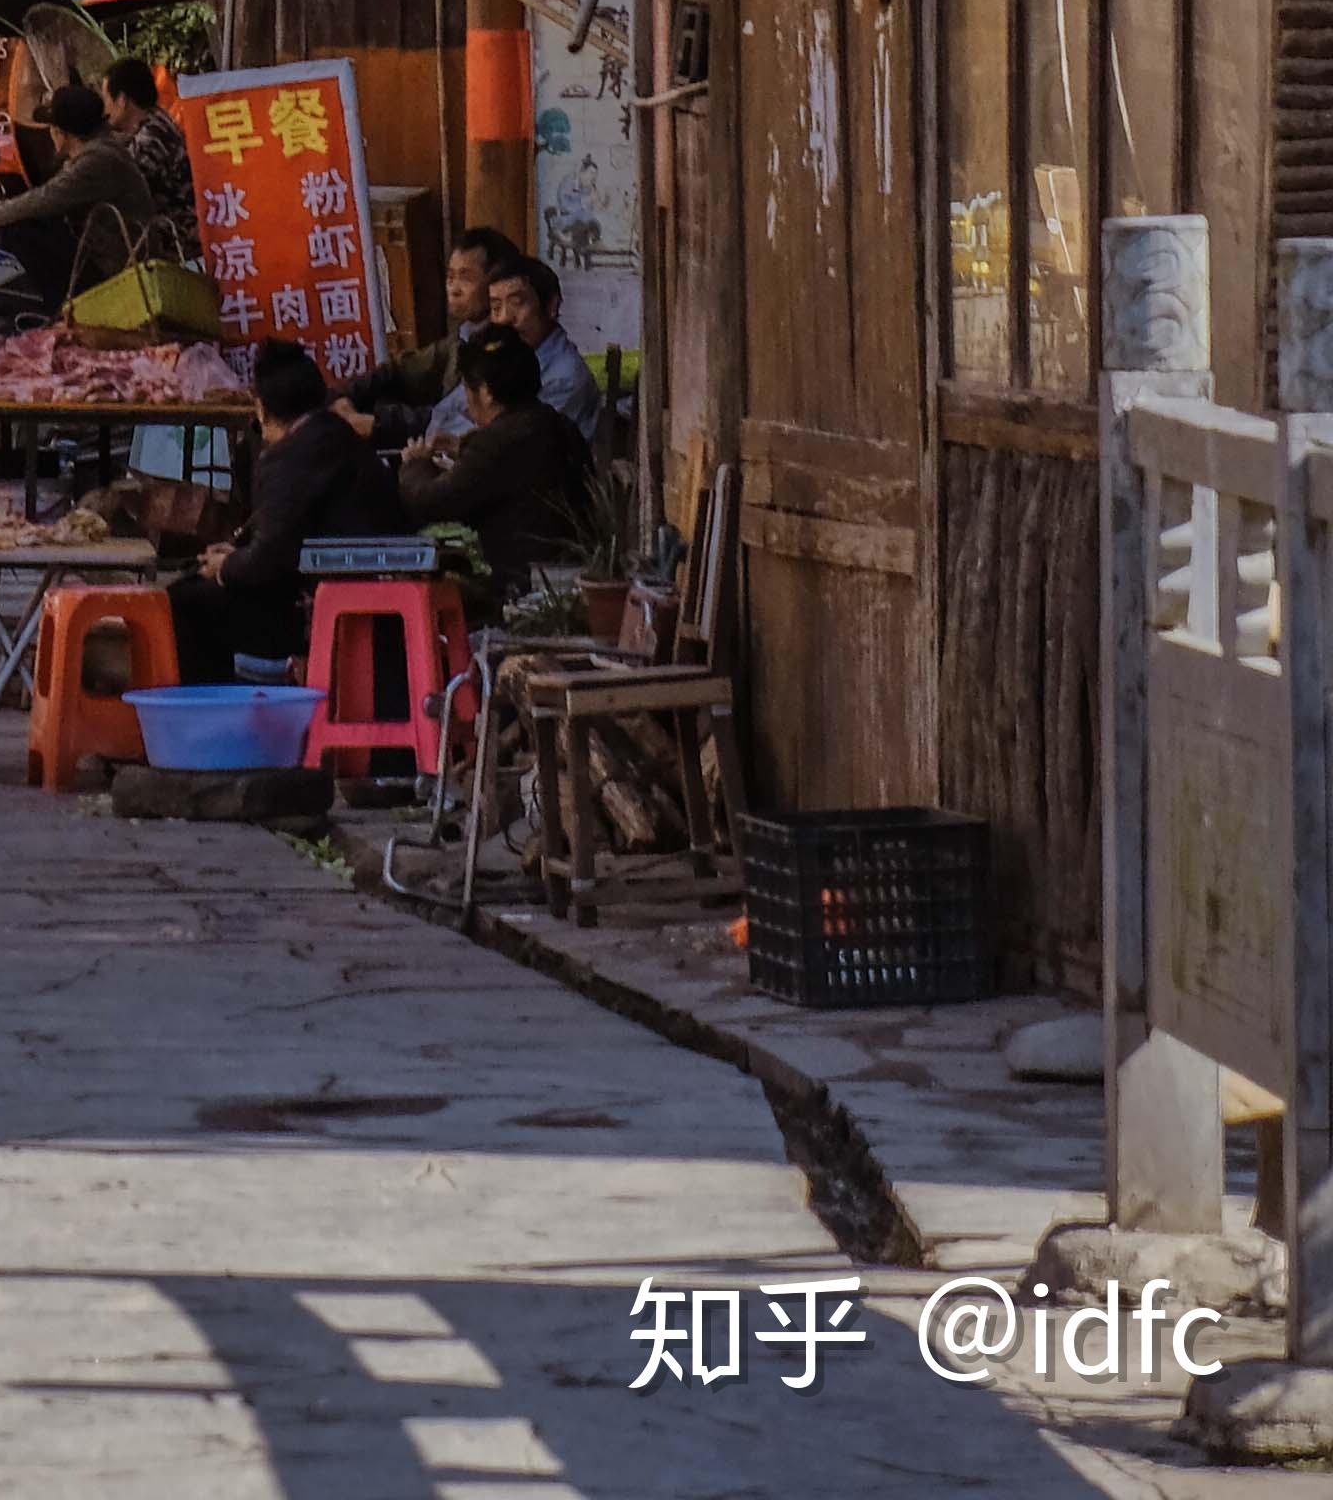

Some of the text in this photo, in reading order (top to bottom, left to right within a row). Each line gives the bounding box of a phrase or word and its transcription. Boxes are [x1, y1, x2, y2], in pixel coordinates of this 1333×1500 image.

[203, 88, 329, 165] 早餐
[203, 167, 348, 229] 冰粉
[210, 223, 356, 282] 凉虾
[219, 277, 362, 335] 牛肉面
